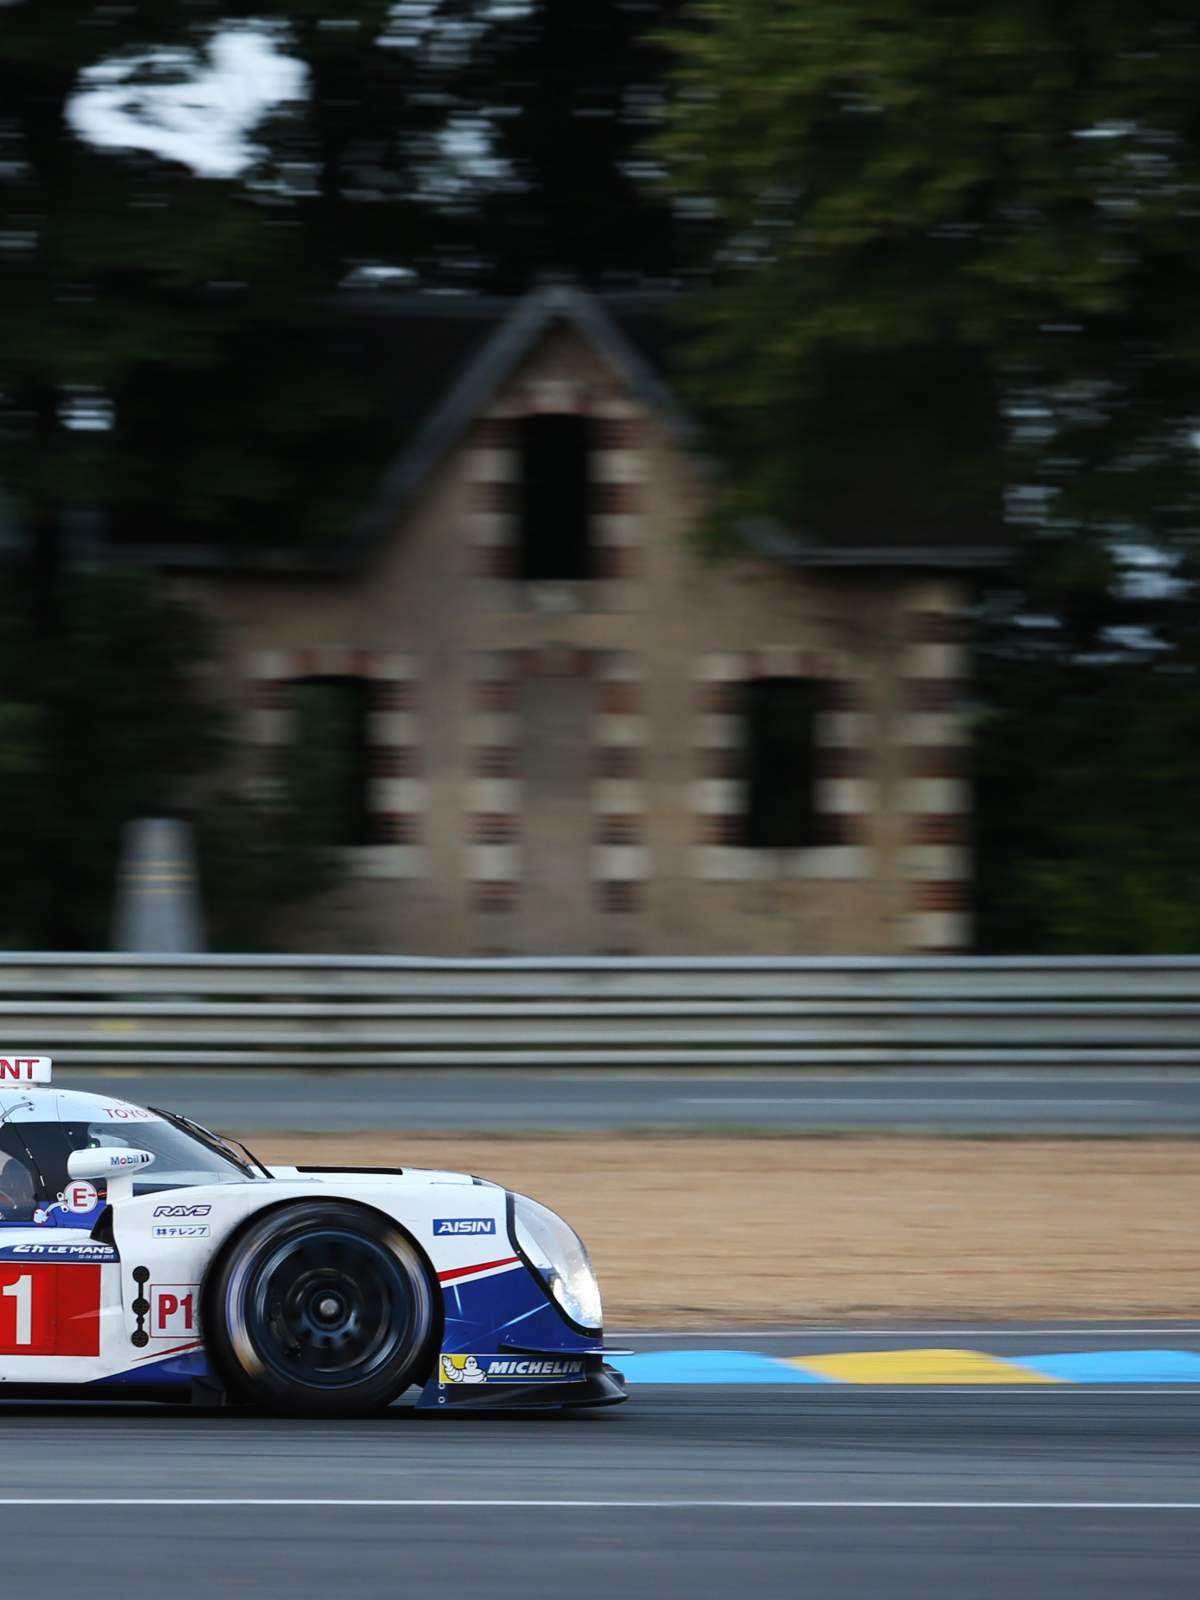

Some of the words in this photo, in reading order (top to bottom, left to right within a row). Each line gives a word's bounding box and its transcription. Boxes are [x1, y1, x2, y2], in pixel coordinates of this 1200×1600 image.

[110, 1154, 139, 1166] Mobil
[72, 1188, 87, 1208] E
[153, 1205, 212, 1217] RAYS
[437, 1221, 492, 1233] AISIN
[47, 1246, 66, 1254] LE
[69, 1246, 115, 1254] MANS
[2, 1275, 33, 1345] 1
[158, 1294, 193, 1330] P1
[487, 1361, 582, 1374] MICHELIN
